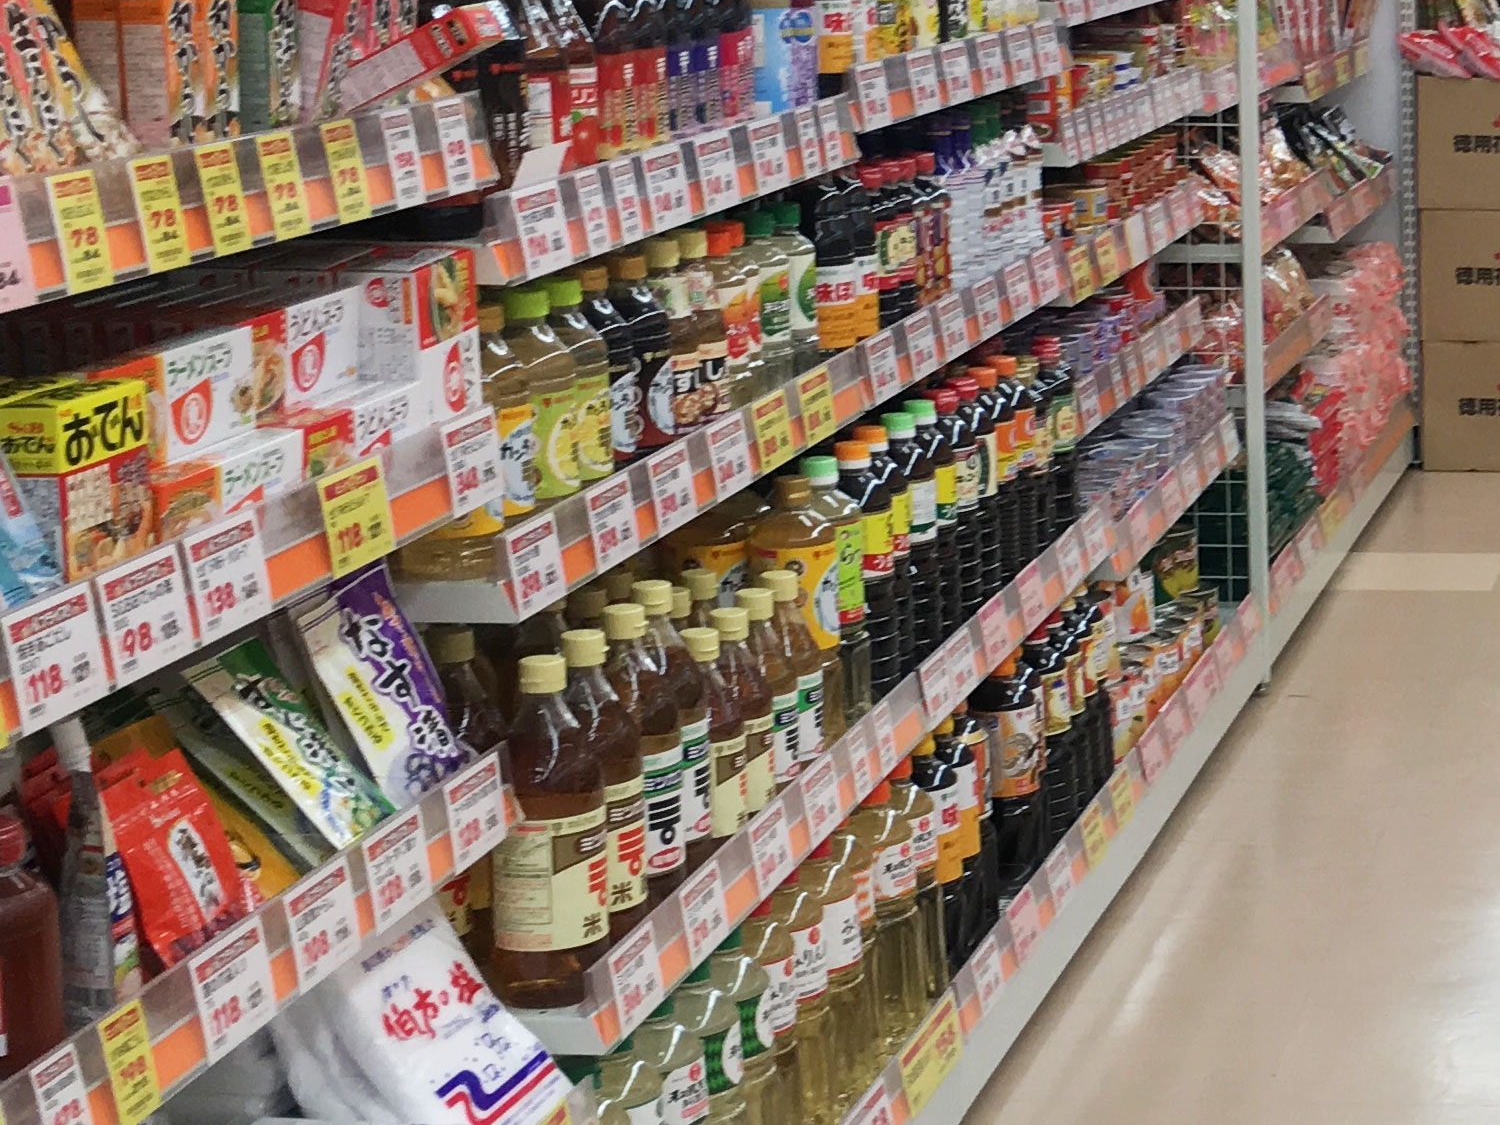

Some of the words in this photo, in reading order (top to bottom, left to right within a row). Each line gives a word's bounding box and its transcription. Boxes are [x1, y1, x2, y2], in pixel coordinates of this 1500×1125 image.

[150, 211, 177, 229] 78
[71, 226, 101, 247] 78
[63, 396, 145, 467] おでん
[122, 622, 153, 658] 98
[28, 664, 63, 704] 118
[611, 880, 633, 906] 米
